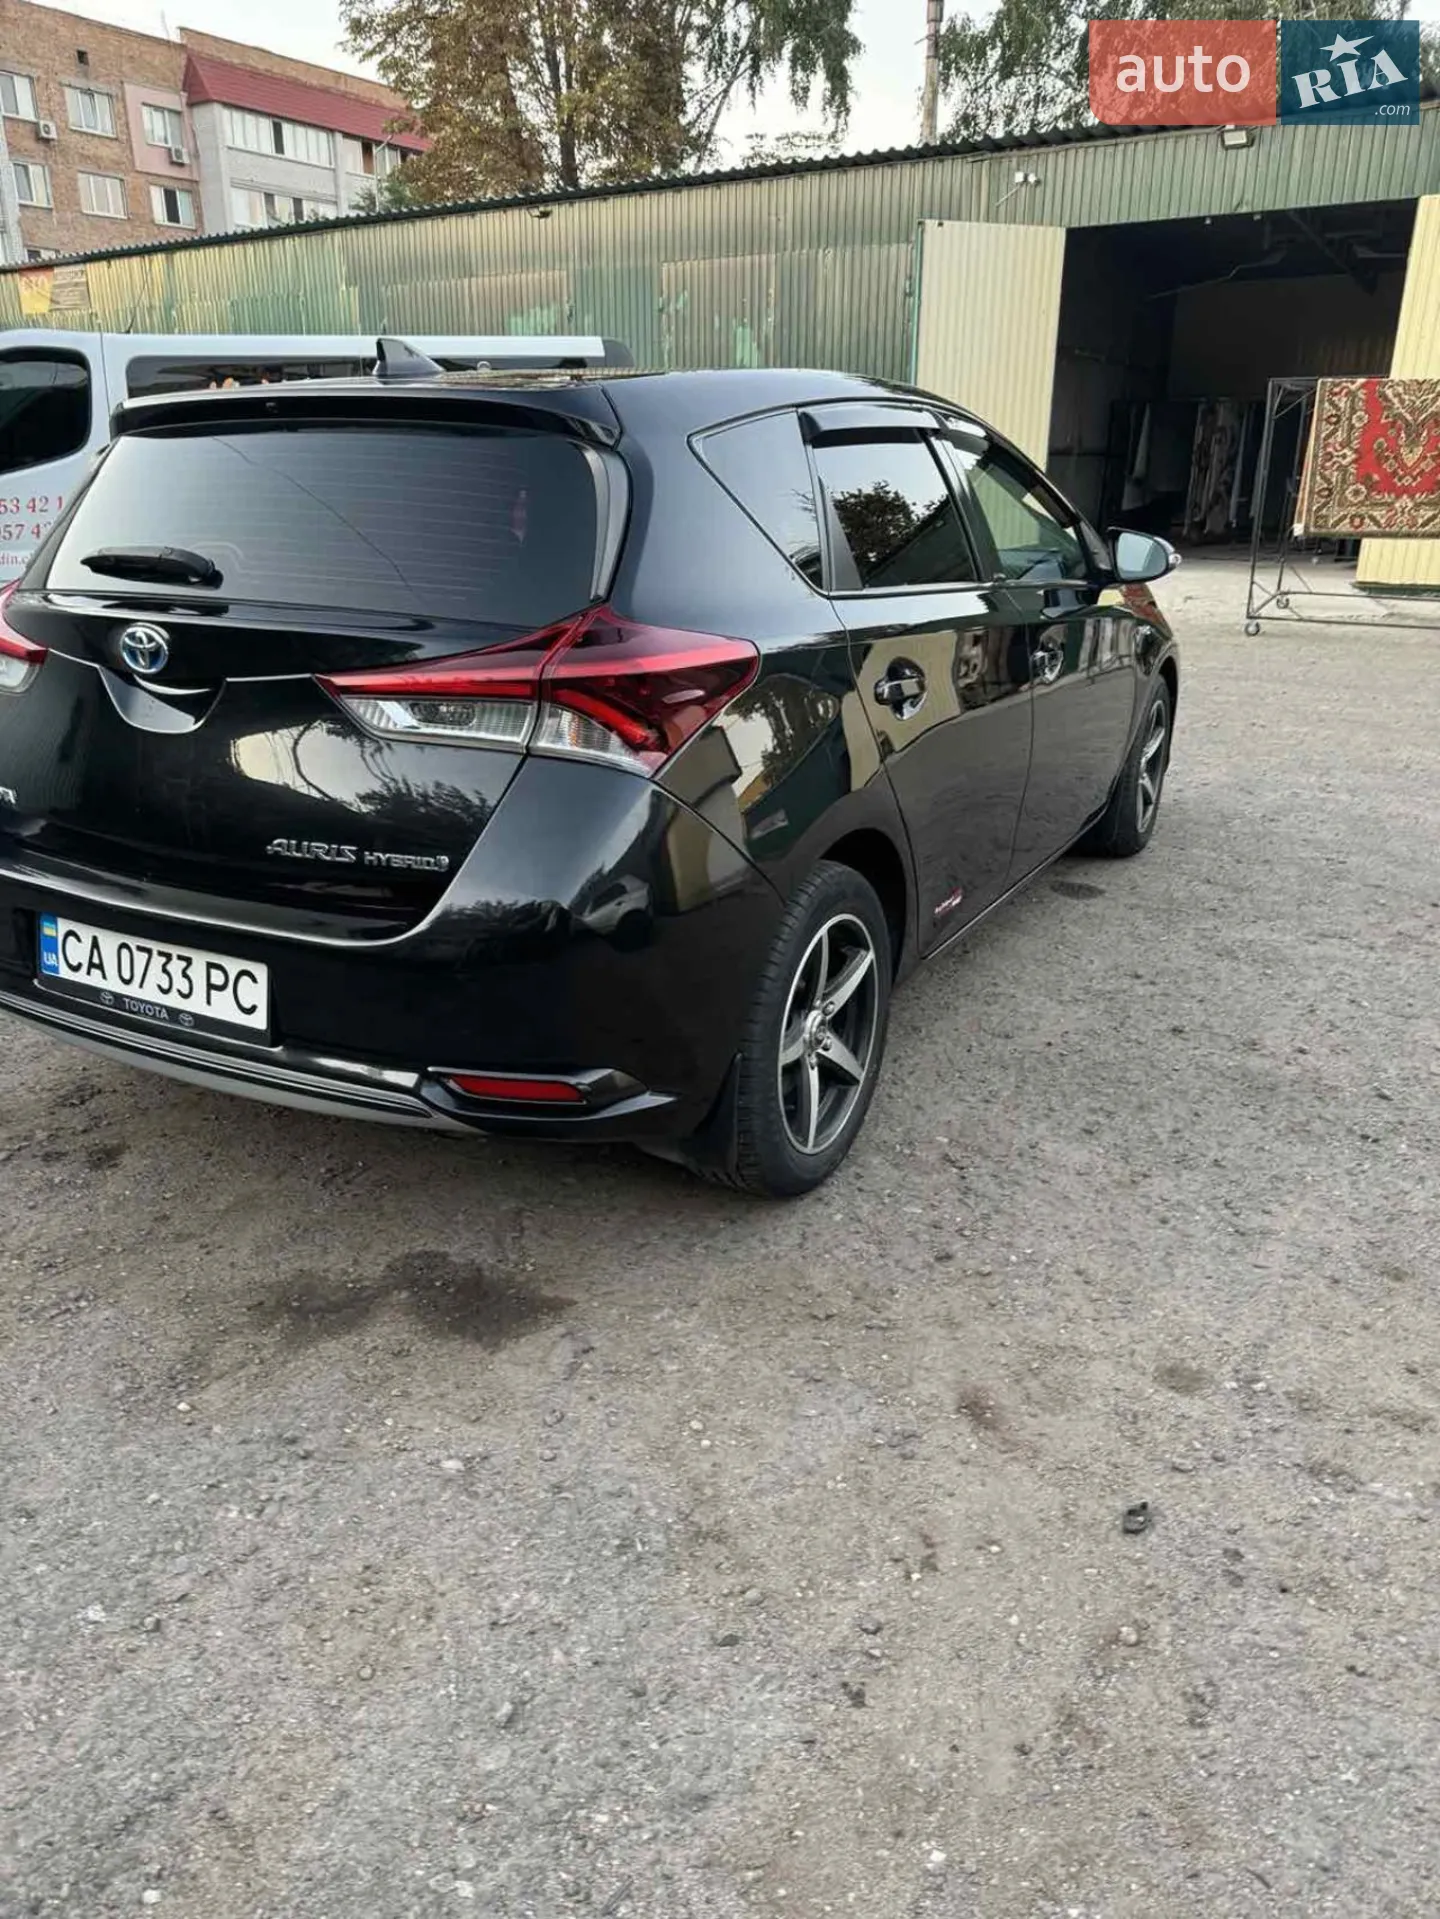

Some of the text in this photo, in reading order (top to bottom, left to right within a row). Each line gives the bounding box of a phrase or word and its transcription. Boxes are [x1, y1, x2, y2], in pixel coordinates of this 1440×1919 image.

[27, 495, 48, 513] 42
[0, 523, 25, 541] 57
[266, 838, 436, 870] AURIS HYBRID
[43, 951, 59, 966] UA
[61, 929, 259, 1015] CA 0733 PC
[122, 997, 169, 1020] TOYOTA
